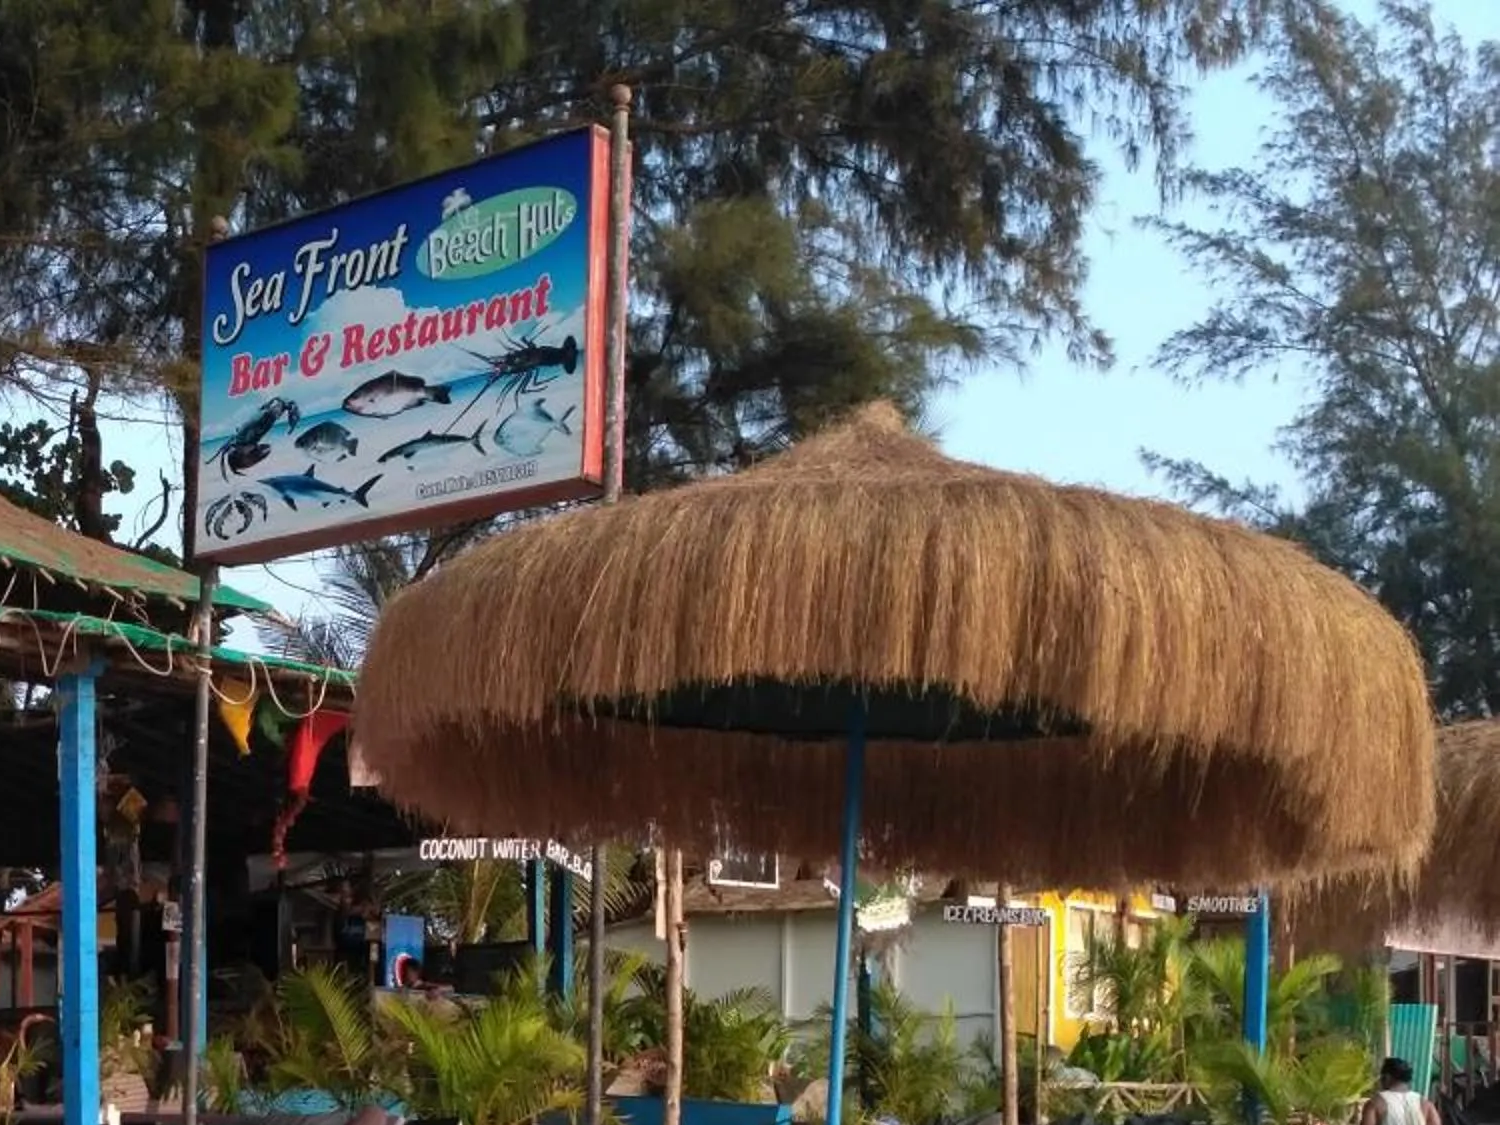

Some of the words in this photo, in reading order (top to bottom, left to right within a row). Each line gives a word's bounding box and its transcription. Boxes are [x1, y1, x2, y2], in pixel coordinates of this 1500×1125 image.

[212, 261, 285, 346] Sea
[288, 223, 408, 325] Front
[428, 217, 508, 279] Beach
[519, 190, 576, 258] Huts
[228, 351, 289, 398] Bar
[299, 331, 331, 378] &
[340, 273, 552, 373] Restaurant
[419, 837, 488, 860] COCONUT
[492, 838, 541, 860] WATER
